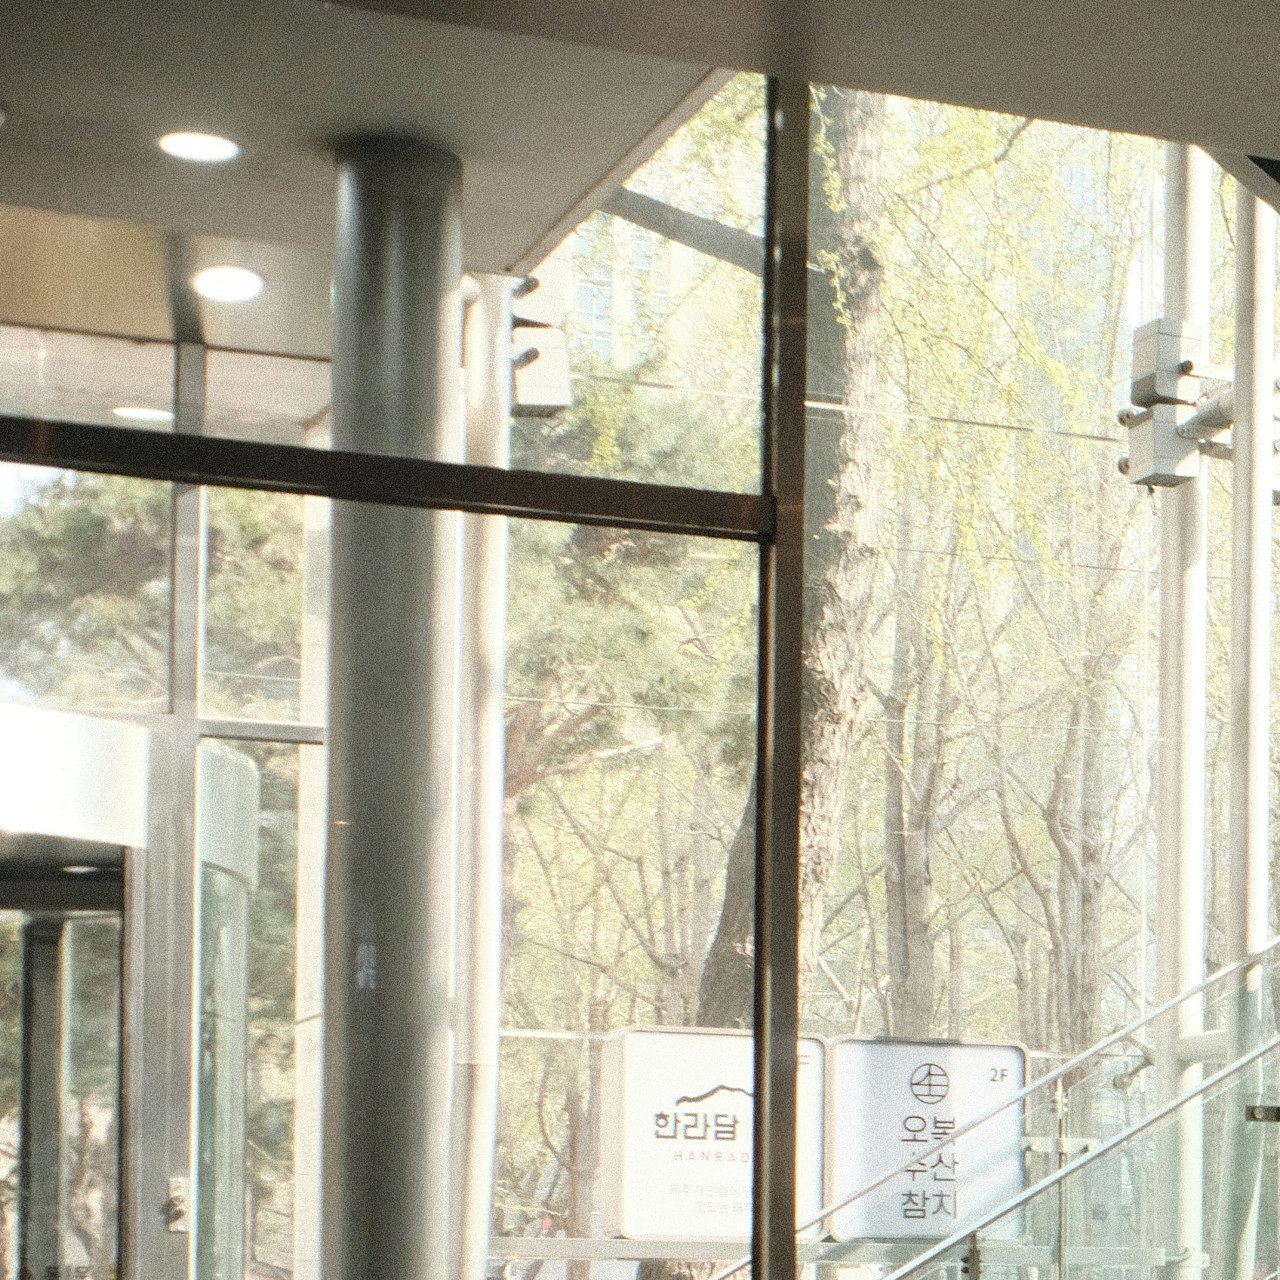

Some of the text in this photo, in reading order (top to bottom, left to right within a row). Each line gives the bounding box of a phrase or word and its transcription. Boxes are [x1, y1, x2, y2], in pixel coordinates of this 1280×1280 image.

[990, 1067, 1008, 1082] 2F
[654, 1111, 740, 1141] 한라담
[901, 1190, 957, 1220] 참치
